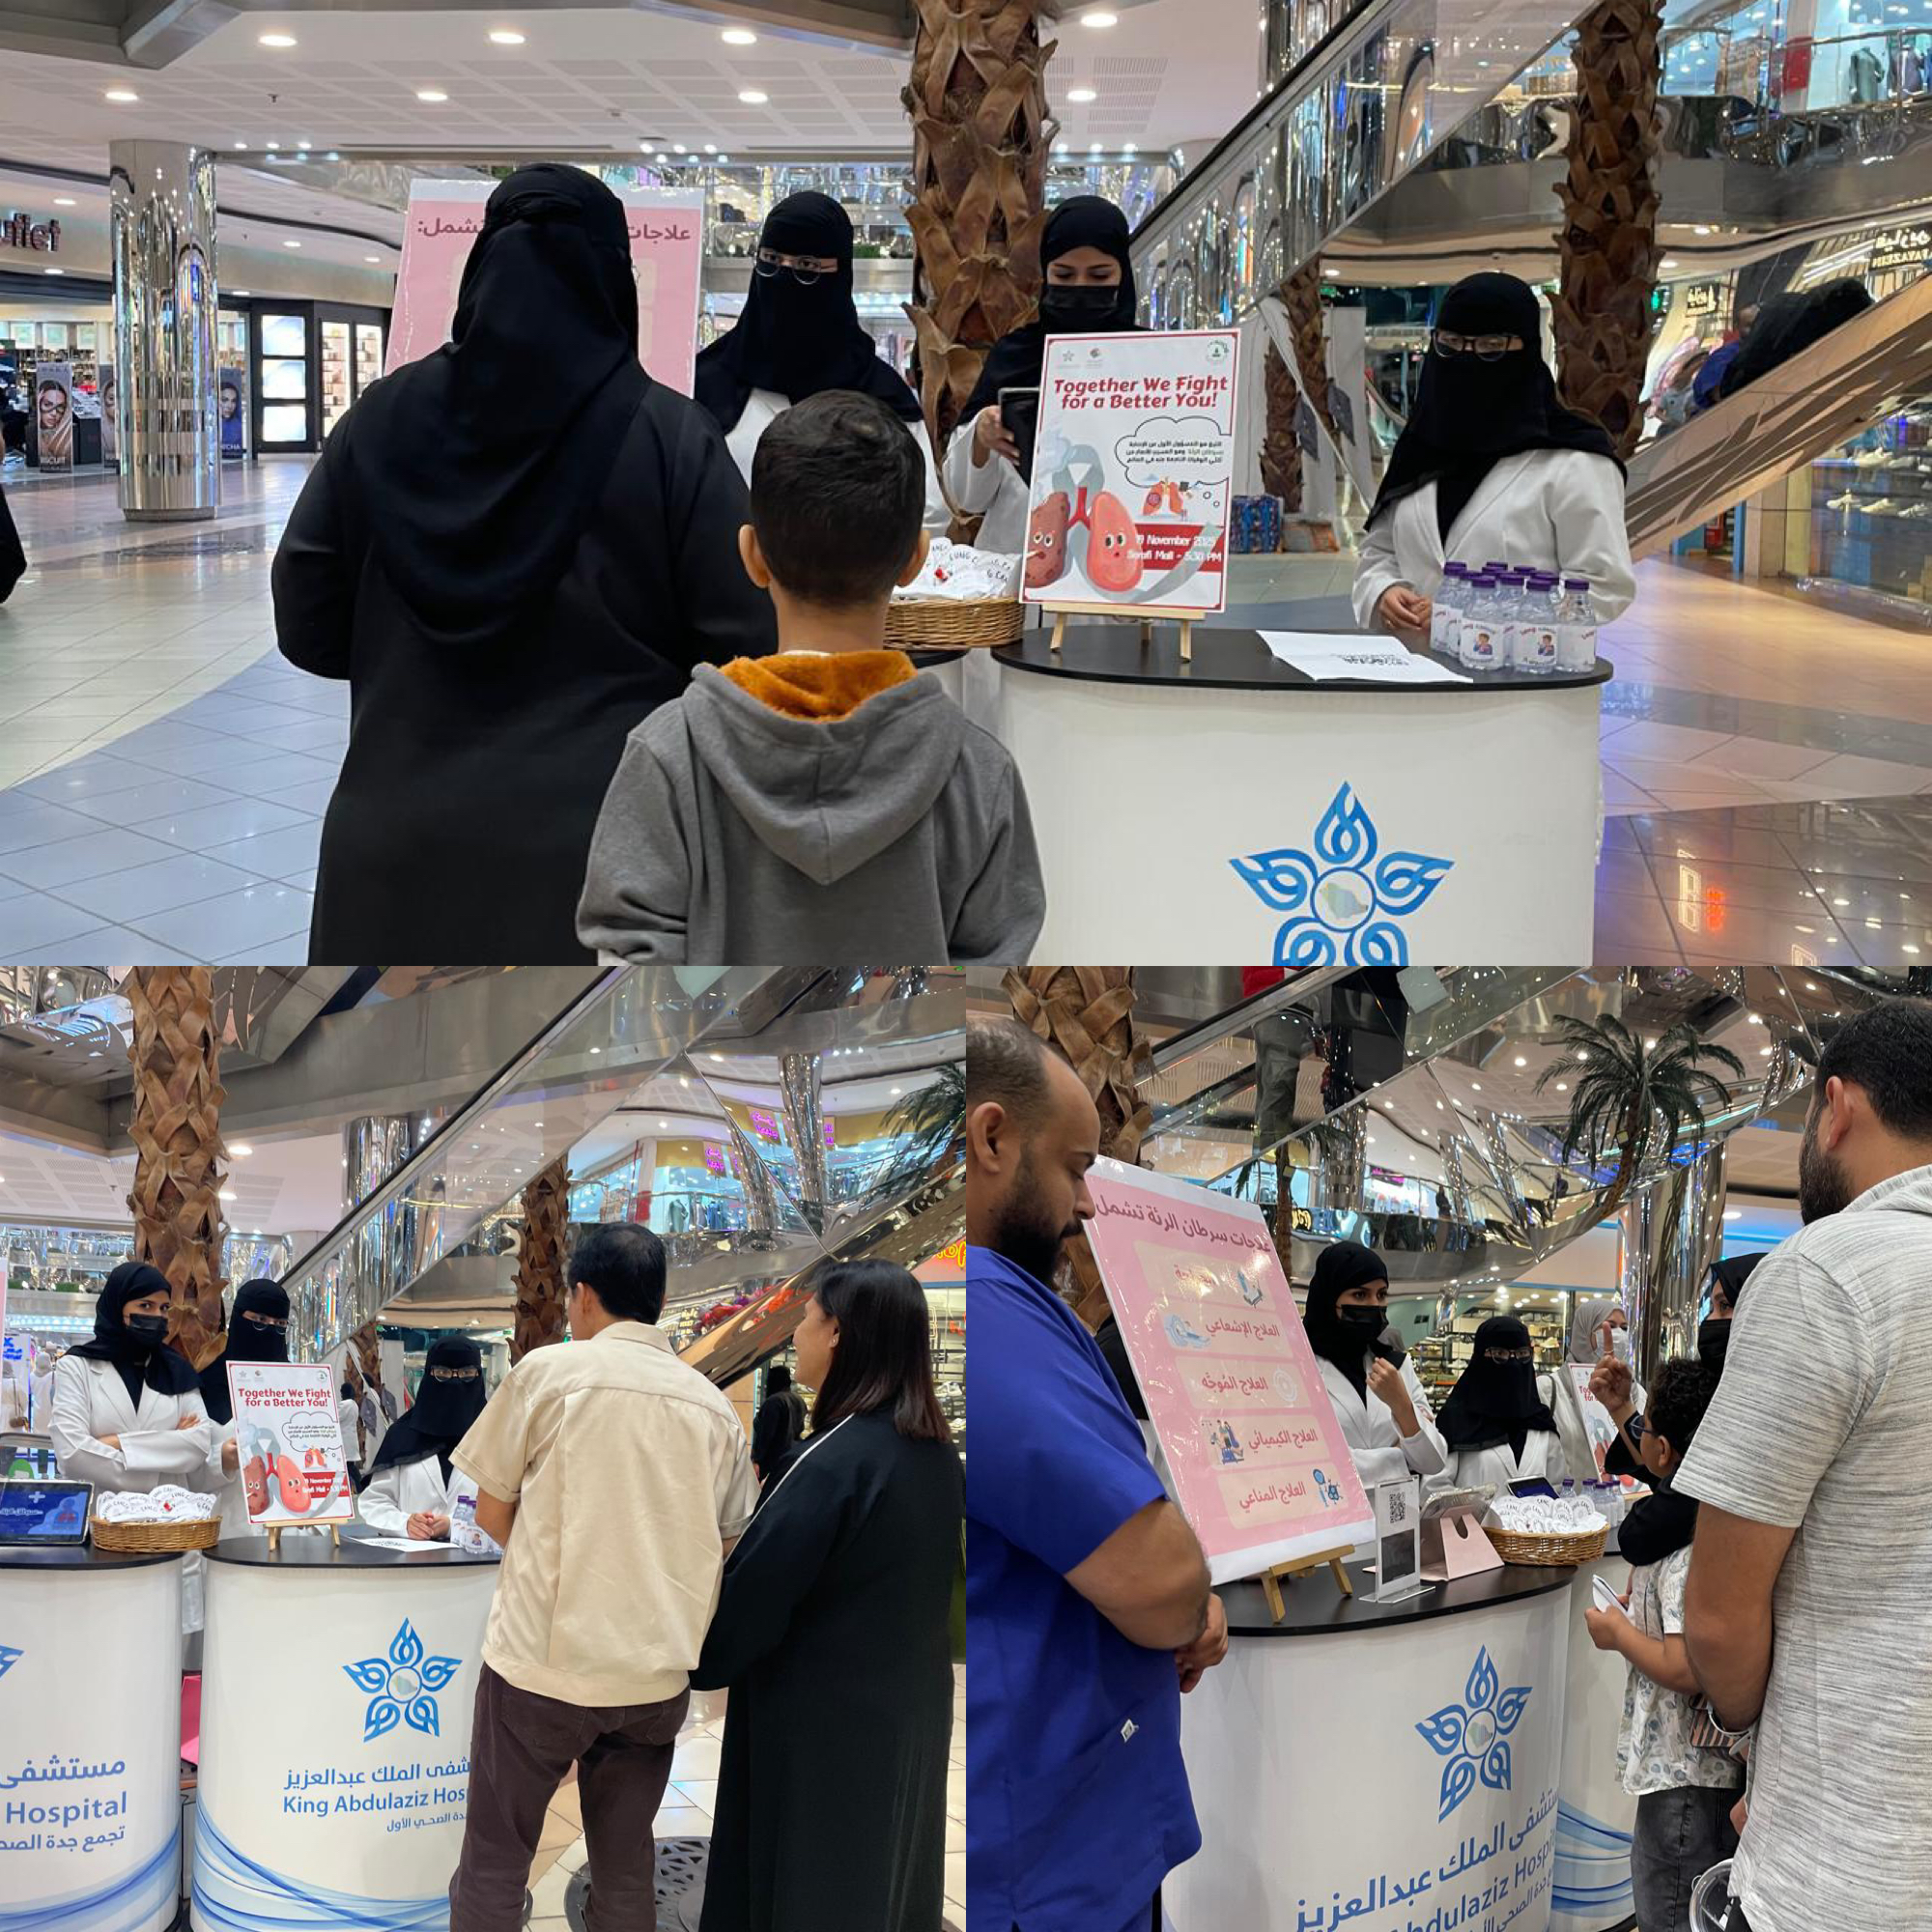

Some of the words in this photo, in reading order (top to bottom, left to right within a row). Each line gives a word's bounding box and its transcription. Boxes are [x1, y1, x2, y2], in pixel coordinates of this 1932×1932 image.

[417, 216, 483, 237] شمل:
[1055, 377, 1138, 397] Together
[1144, 378, 1171, 391] We
[1176, 375, 1228, 397] Fight
[1062, 394, 1089, 410] for
[1094, 397, 1104, 409] a
[1110, 393, 1171, 409] Better
[1177, 392, 1217, 408] You!
[1147, 534, 1191, 546] November
[1148, 1205, 1179, 1231] الرئة
[1182, 1216, 1228, 1241] سرطان
[1231, 1232, 1271, 1253] علاجات
[1206, 1319, 1252, 1338] الإشعاعي
[1254, 1324, 1280, 1341] العلاج
[238, 1388, 285, 1400] Together
[288, 1388, 303, 1398] We
[305, 1389, 331, 1400] Fight
[1240, 1377, 1268, 1395] العلاج
[245, 1397, 261, 1406] for
[273, 1398, 305, 1406] Better
[1248, 1430, 1292, 1454] الكيميائي
[1293, 1429, 1319, 1448] العلاج
[1239, 1486, 1277, 1513] المناعي
[1278, 1481, 1306, 1504] العلاج
[0, 1754, 126, 1789] مستشفى
[371, 1764, 420, 1783] الملك
[426, 1756, 470, 1778] شفى
[283, 1769, 366, 1790] عبدالعزيز
[6, 1791, 127, 1828] Hospital
[283, 1796, 329, 1817] King
[334, 1790, 429, 1812] Abdulaziz
[386, 1818, 412, 1833] الأول
[46, 1834, 77, 1853] جدة
[82, 1825, 126, 1853] تجمع
[1438, 1821, 1504, 1882] الملك
[1296, 1870, 1433, 1932] عبدالعزيز
